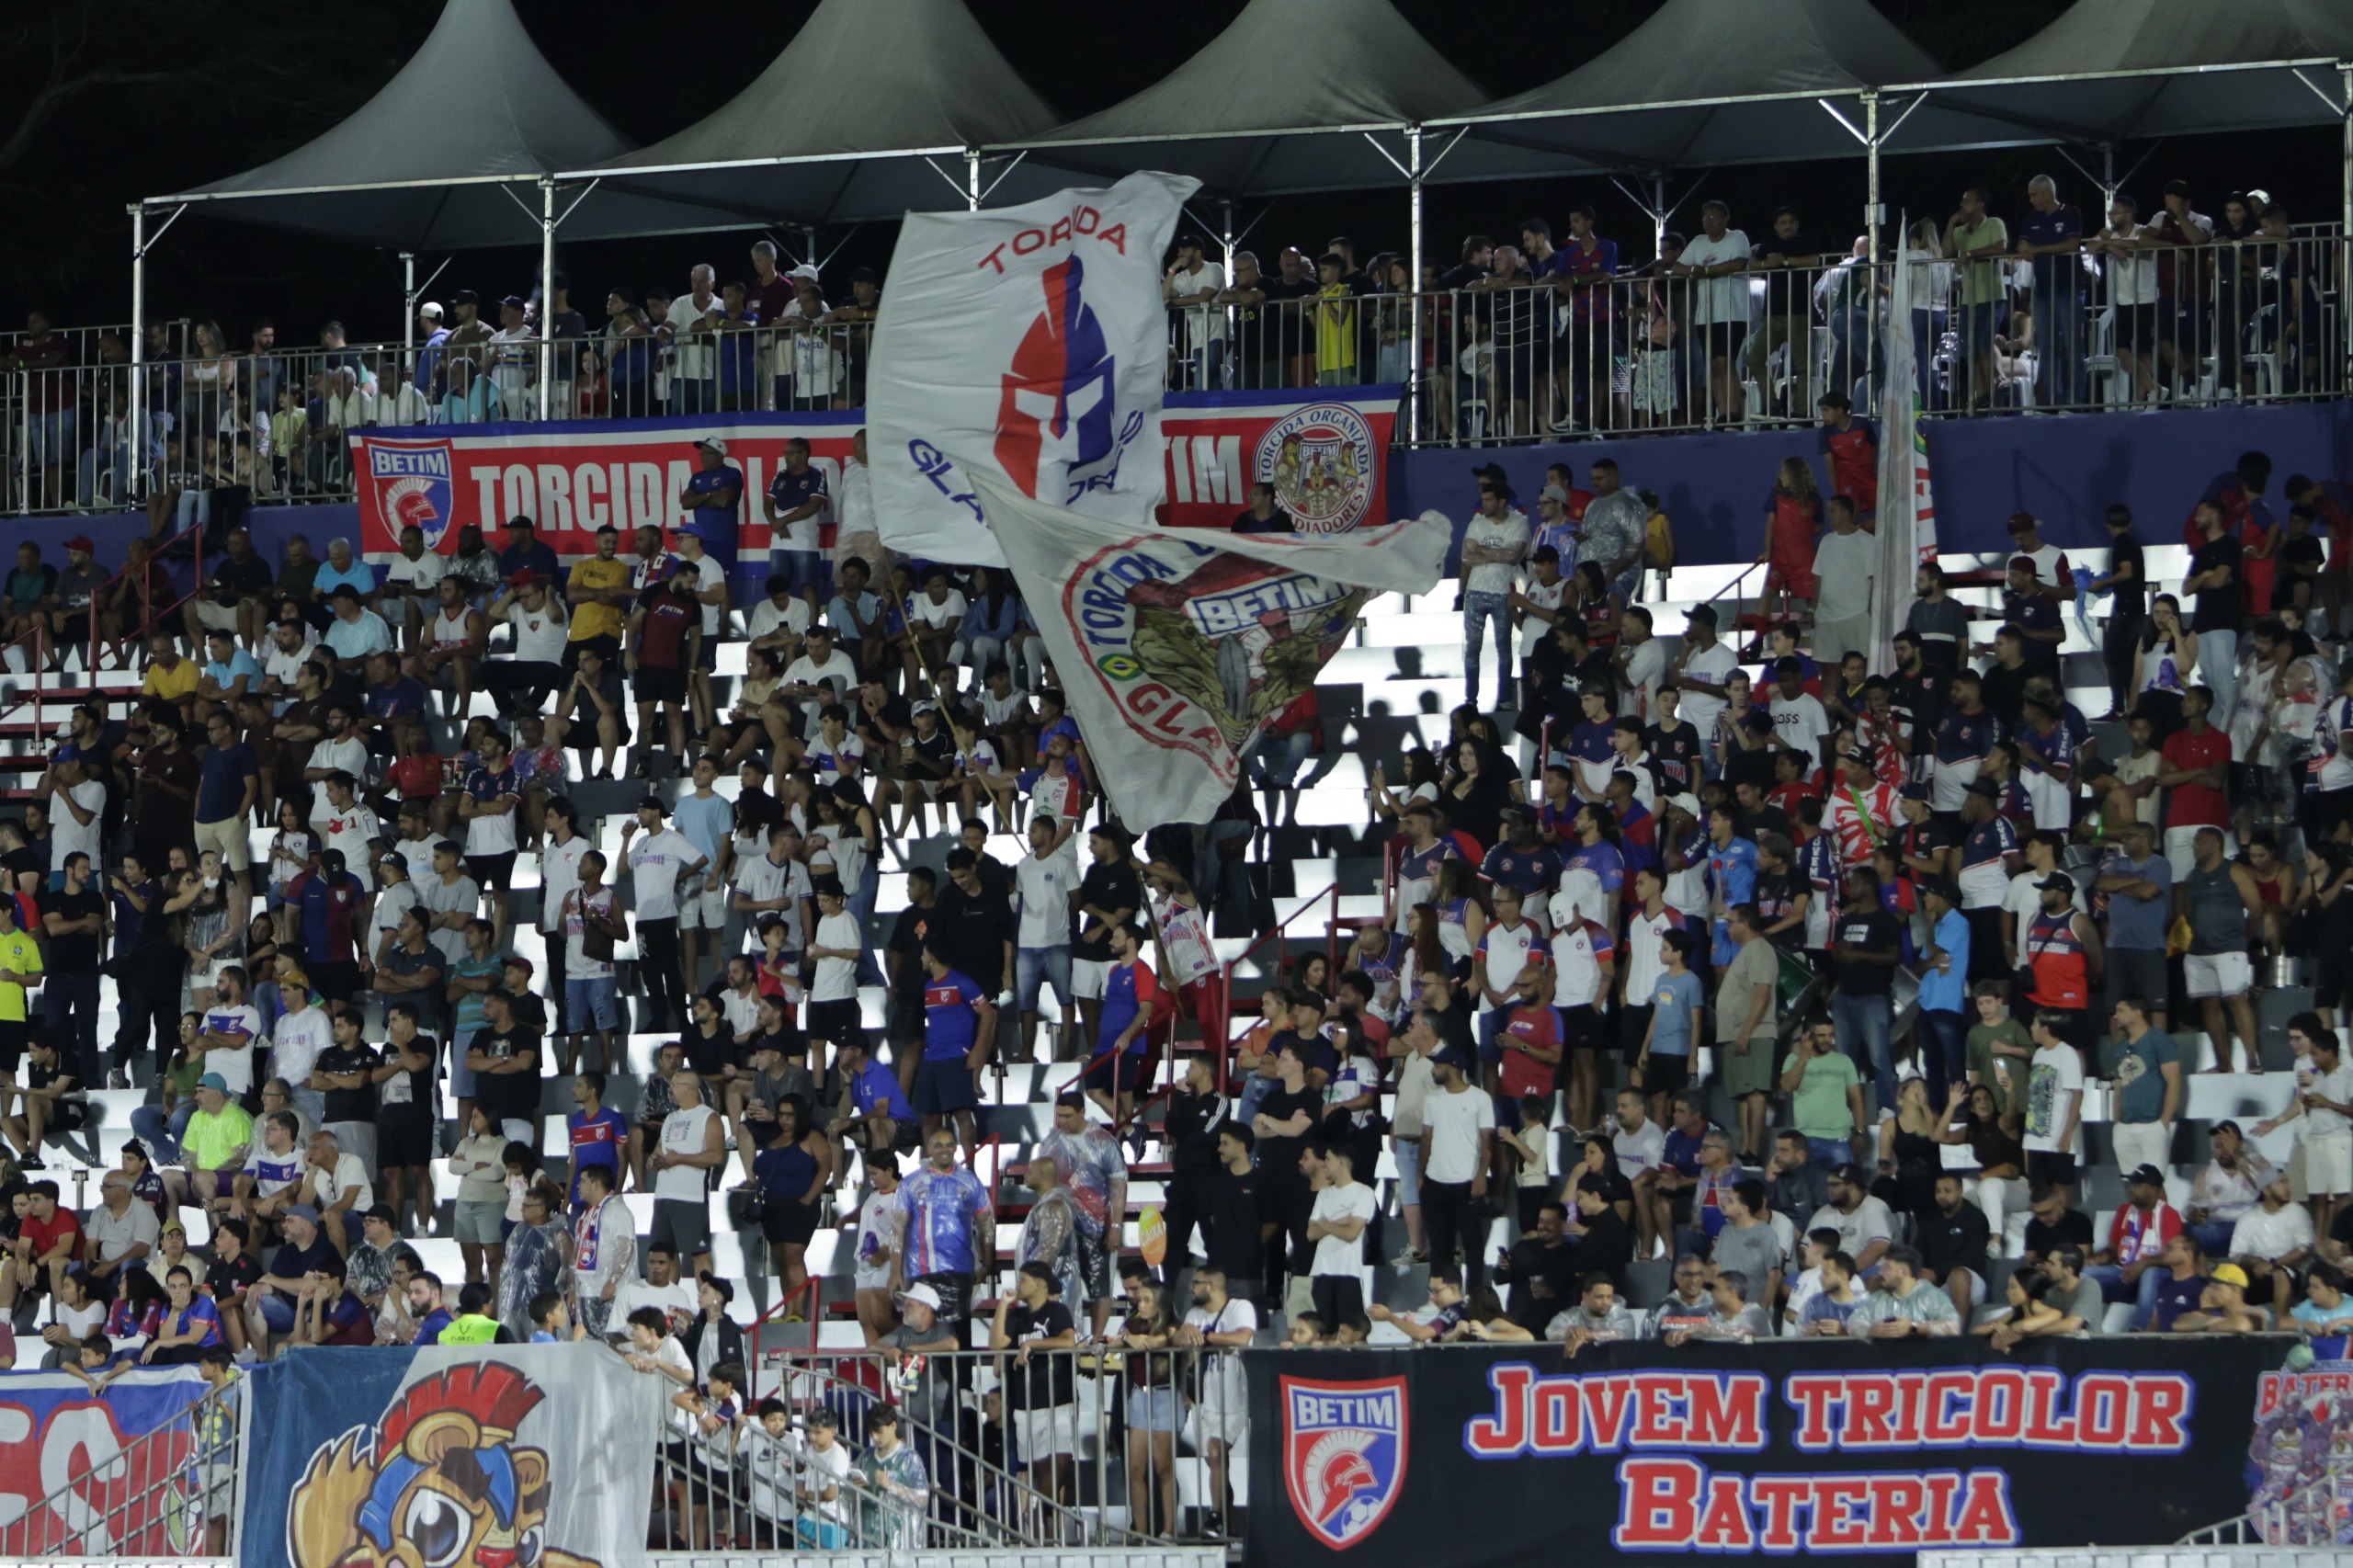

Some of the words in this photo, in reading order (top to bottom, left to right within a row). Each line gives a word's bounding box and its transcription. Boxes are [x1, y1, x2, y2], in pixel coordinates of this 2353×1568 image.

[374, 450, 447, 476] BETIM
[1261, 416, 1304, 478] TORCIDA
[1310, 410, 1370, 475] ORGANIZADA
[470, 460, 698, 533] TORCIDA
[1198, 573, 1346, 634] BETIM
[1140, 1222, 1164, 1248] CAIXA
[1296, 1395, 1393, 1428] BETIM
[1467, 1362, 1768, 1455] JOVEM
[1790, 1369, 2191, 1451] TRICOLOR
[1614, 1456, 2020, 1549] BATERIA
